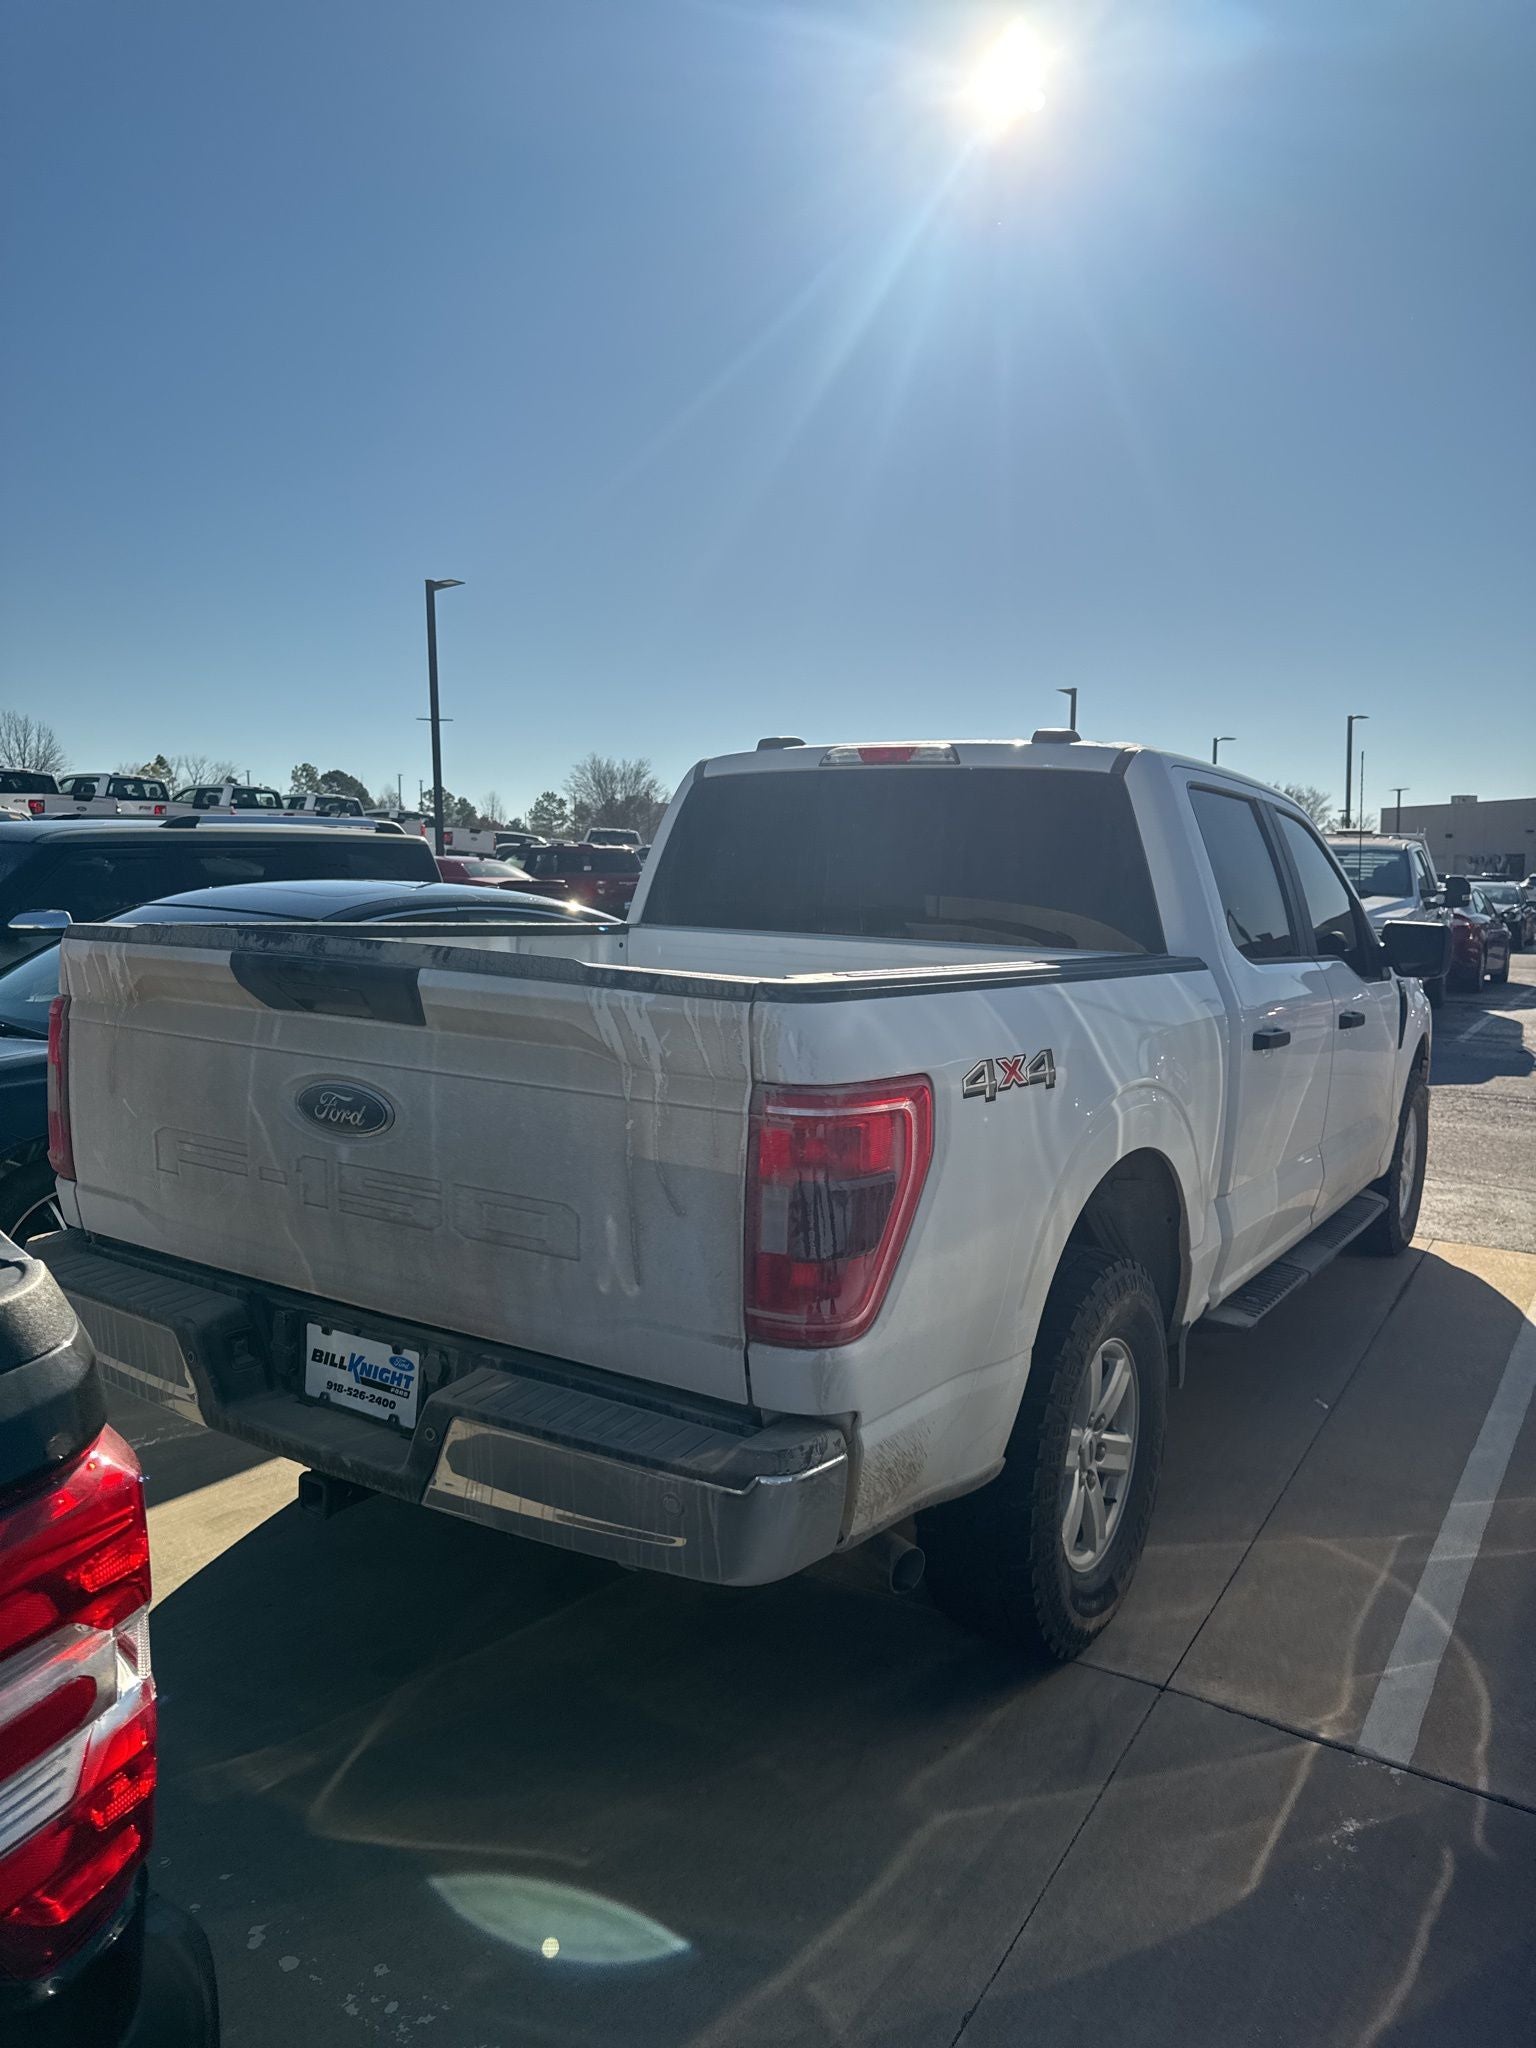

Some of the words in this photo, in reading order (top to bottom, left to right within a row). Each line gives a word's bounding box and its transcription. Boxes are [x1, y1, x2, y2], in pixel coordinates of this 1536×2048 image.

[961, 1048, 1056, 1103] 4X4
[314, 1091, 367, 1127] Ford
[155, 1126, 581, 1261] F-150
[326, 1380, 397, 1410] 918-526-2400
